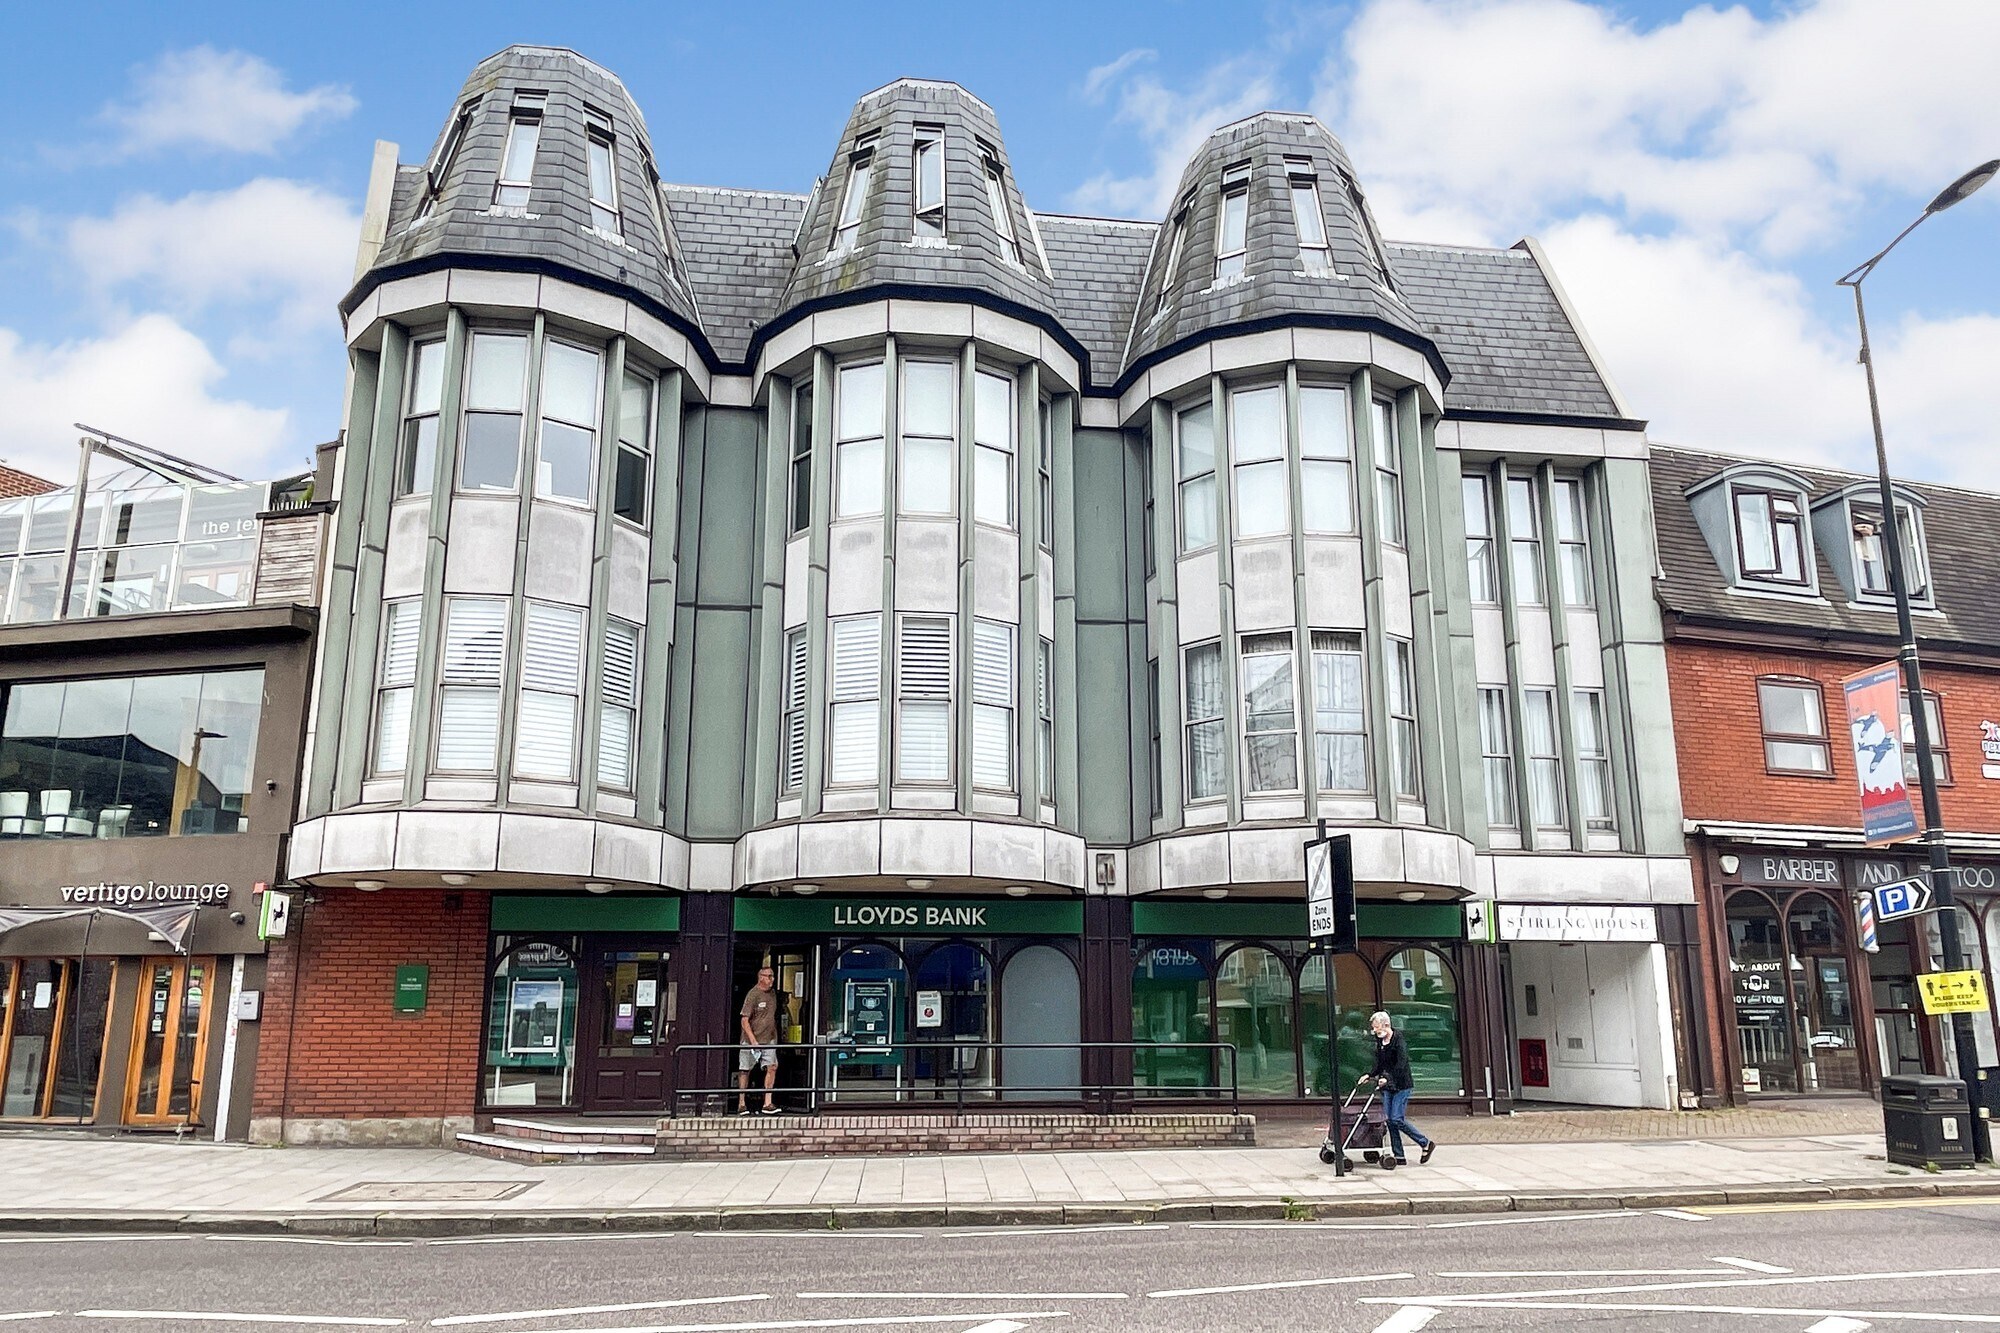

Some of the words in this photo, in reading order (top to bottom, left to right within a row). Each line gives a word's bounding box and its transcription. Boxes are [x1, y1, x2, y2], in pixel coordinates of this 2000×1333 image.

[202, 521, 230, 535] the
[1763, 858, 1838, 882] BARBER
[1862, 863, 1901, 884] AND
[1919, 865, 1996, 889] TTOO
[1885, 889, 1905, 912] P
[834, 906, 918, 925] LLOYDS
[925, 907, 987, 926] BANK
[1314, 905, 1327, 915] Zone
[1312, 917, 1332, 931] ENDS
[1507, 917, 1586, 929] STIRLING
[1595, 918, 1649, 929] HOUSE
[1751, 962, 1781, 971] ABOUT
